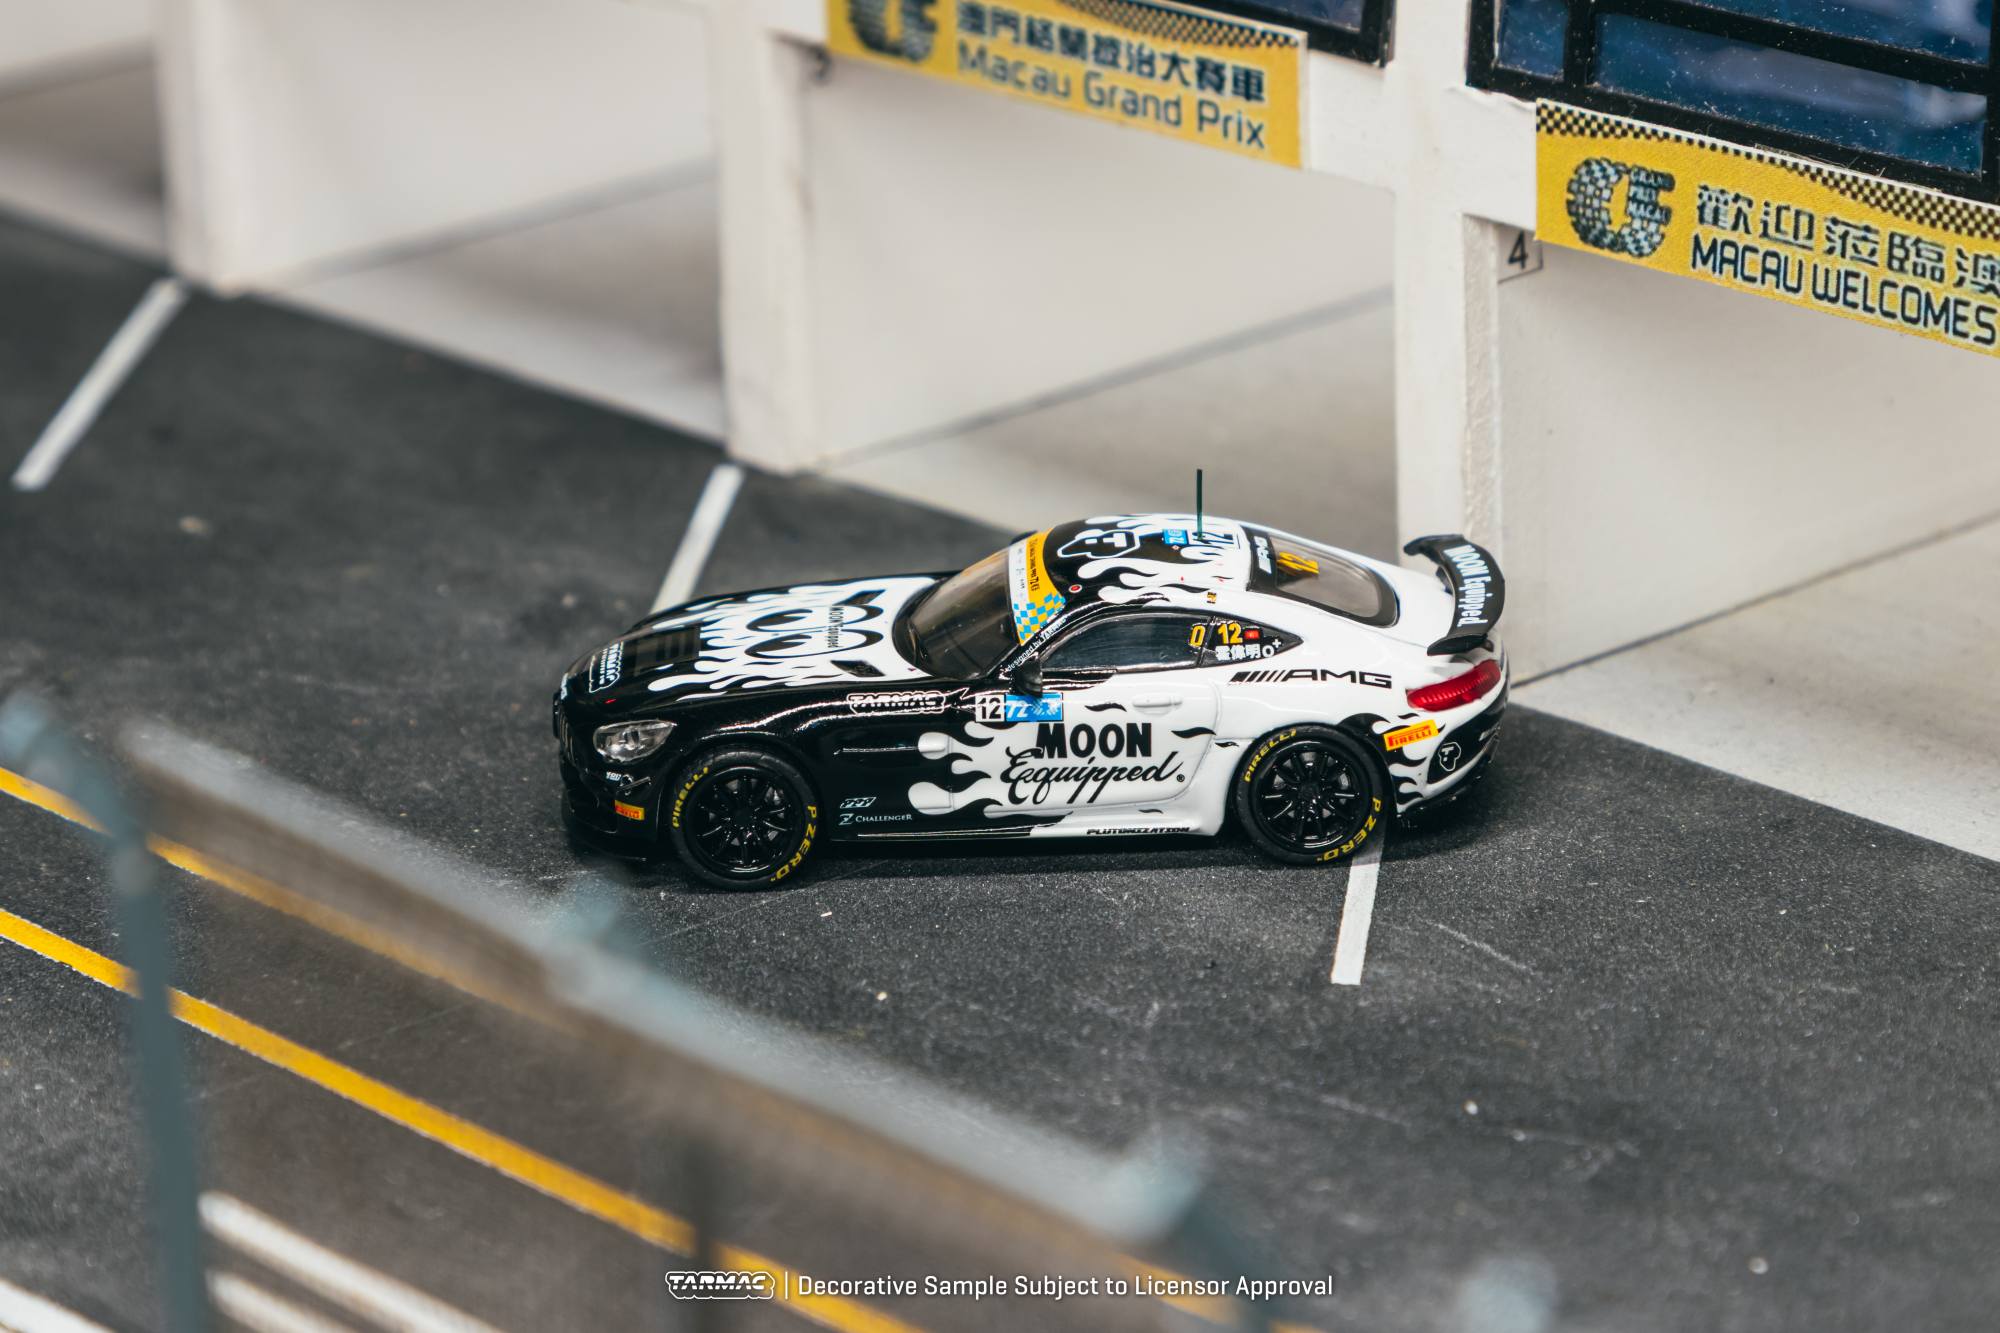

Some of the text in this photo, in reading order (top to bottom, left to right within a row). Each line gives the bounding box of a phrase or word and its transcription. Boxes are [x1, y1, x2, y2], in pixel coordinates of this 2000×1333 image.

[957, 40, 1265, 149] Macau Grand Prix
[1508, 231, 1528, 269] 4
[1691, 233, 1998, 346] MACAU WELCOMES
[1217, 622, 1244, 645] 12
[1281, 669, 1392, 689] AMG
[980, 697, 1001, 720] 12
[1036, 723, 1152, 758] MOON
[1388, 725, 1432, 747] PIRELLI
[1244, 728, 1297, 783] PIRELLI
